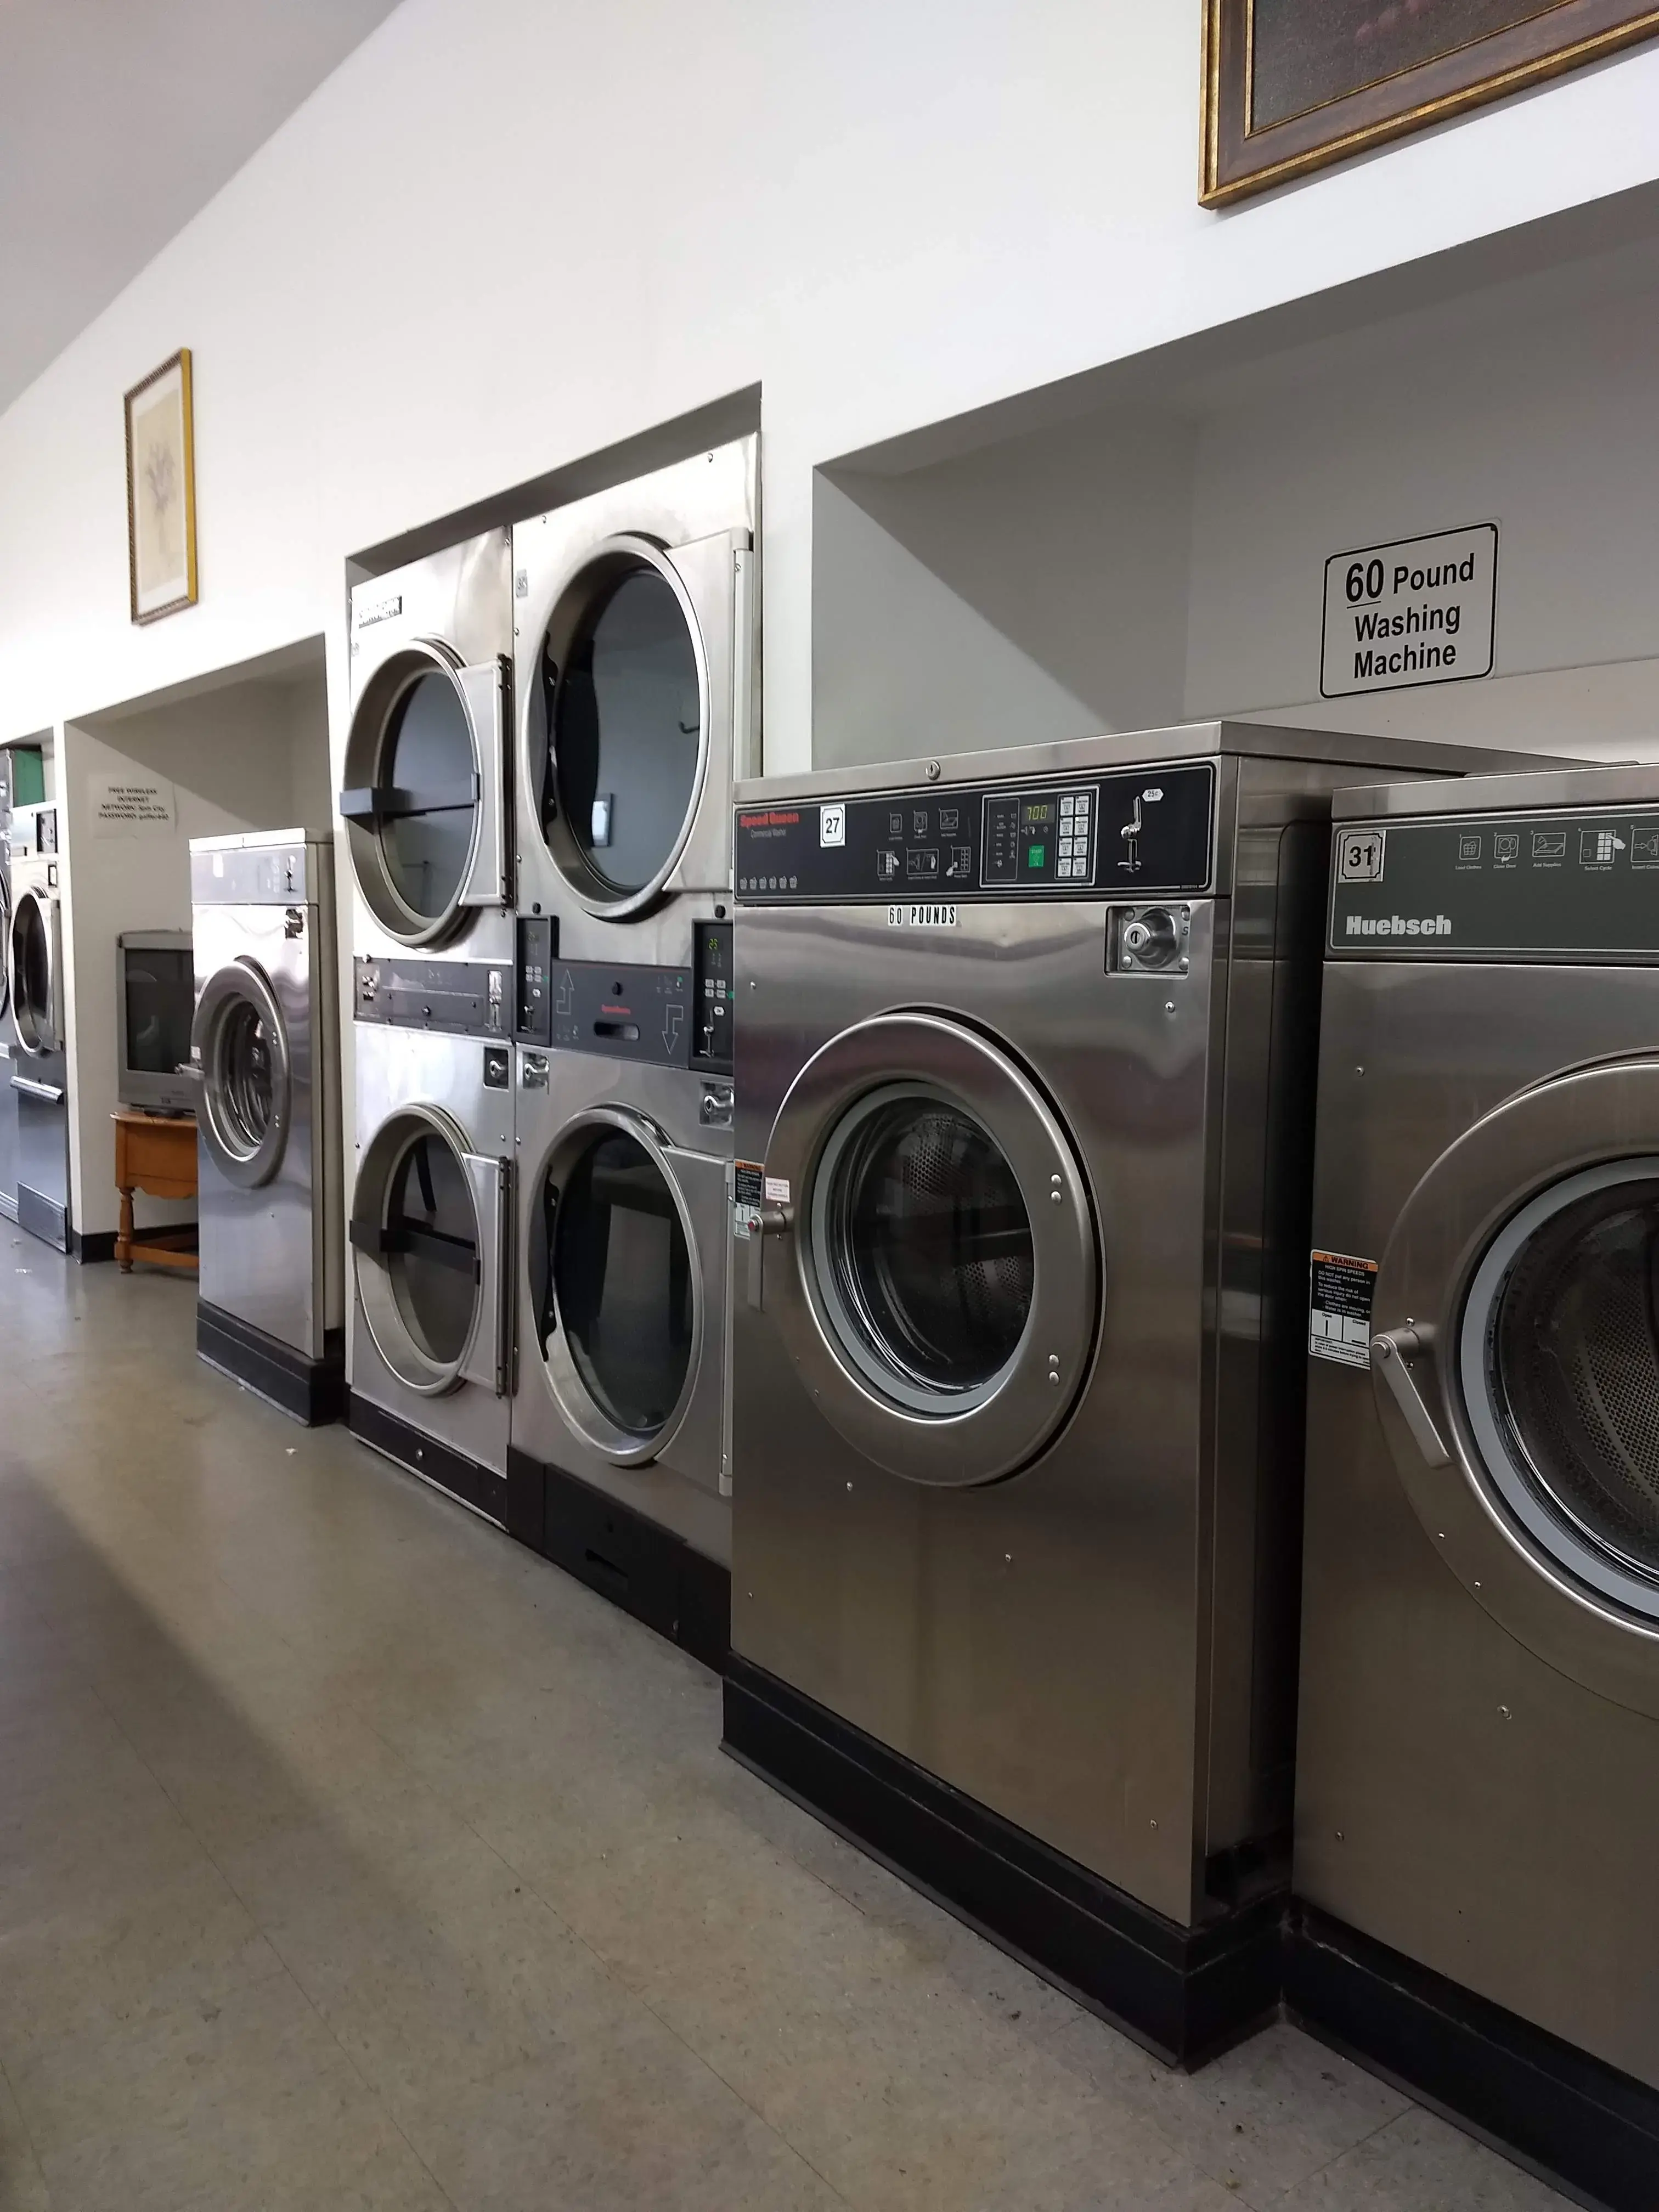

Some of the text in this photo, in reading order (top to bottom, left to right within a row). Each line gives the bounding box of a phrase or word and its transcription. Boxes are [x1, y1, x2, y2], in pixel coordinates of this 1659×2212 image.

[1346, 552, 1475, 602] 60 Pound
[1355, 603, 1460, 642] Washing
[1354, 642, 1456, 679] Machine
[1028, 805, 1048, 821] 700
[825, 817, 840, 834] 27
[1348, 845, 1372, 866] 31
[889, 906, 955, 924] 60 POUNDS
[1346, 915, 1452, 935] Huebsch
[1331, 1255, 1369, 1269] WARNING
